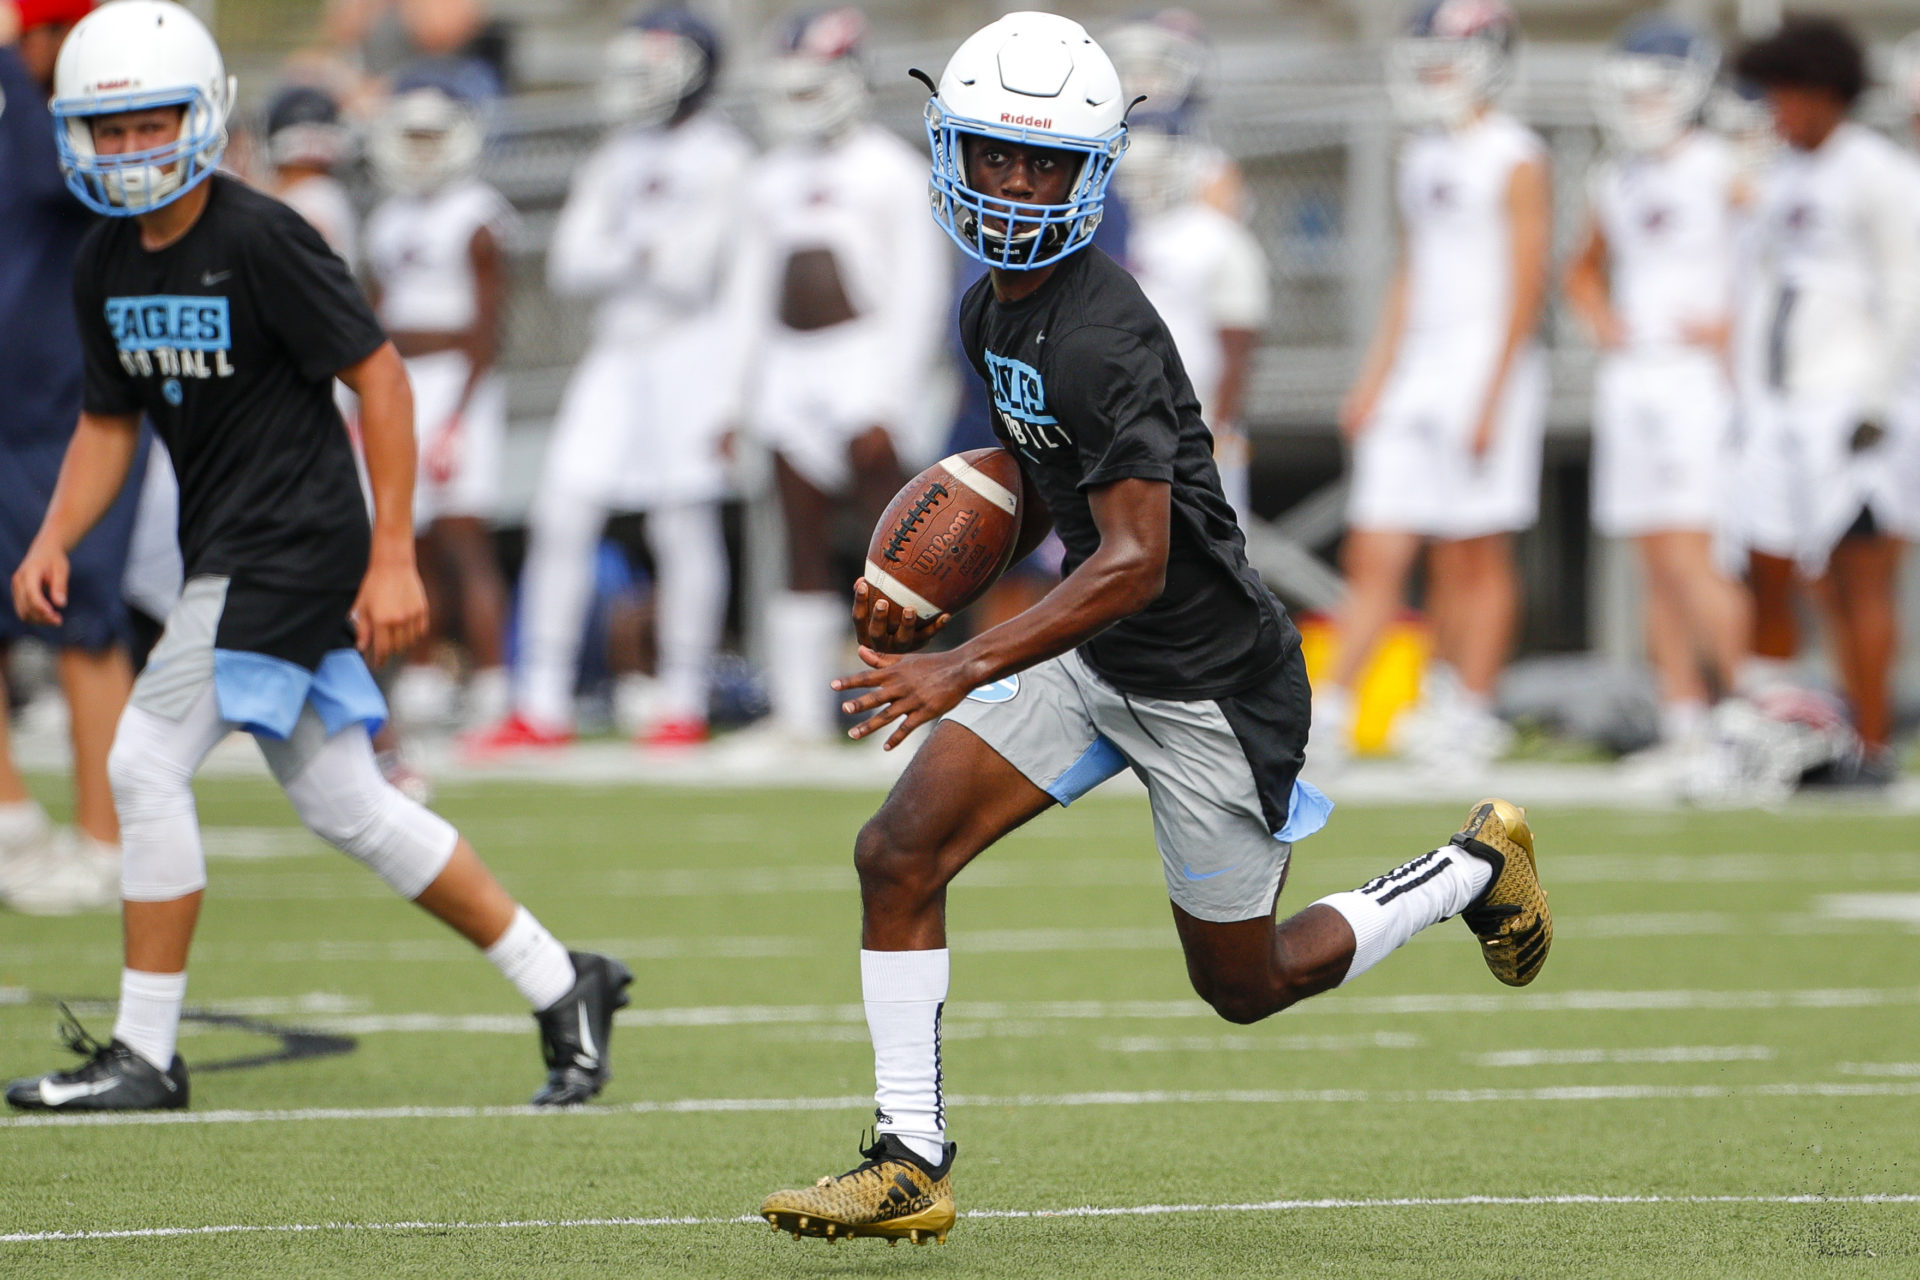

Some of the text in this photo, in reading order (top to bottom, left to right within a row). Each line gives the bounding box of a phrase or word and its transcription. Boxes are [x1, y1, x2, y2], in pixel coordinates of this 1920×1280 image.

[1000, 113, 1052, 129] Riddell
[993, 247, 1020, 255] Ridell
[911, 510, 973, 575] Wilson
[871, 1195, 934, 1222] adidas
